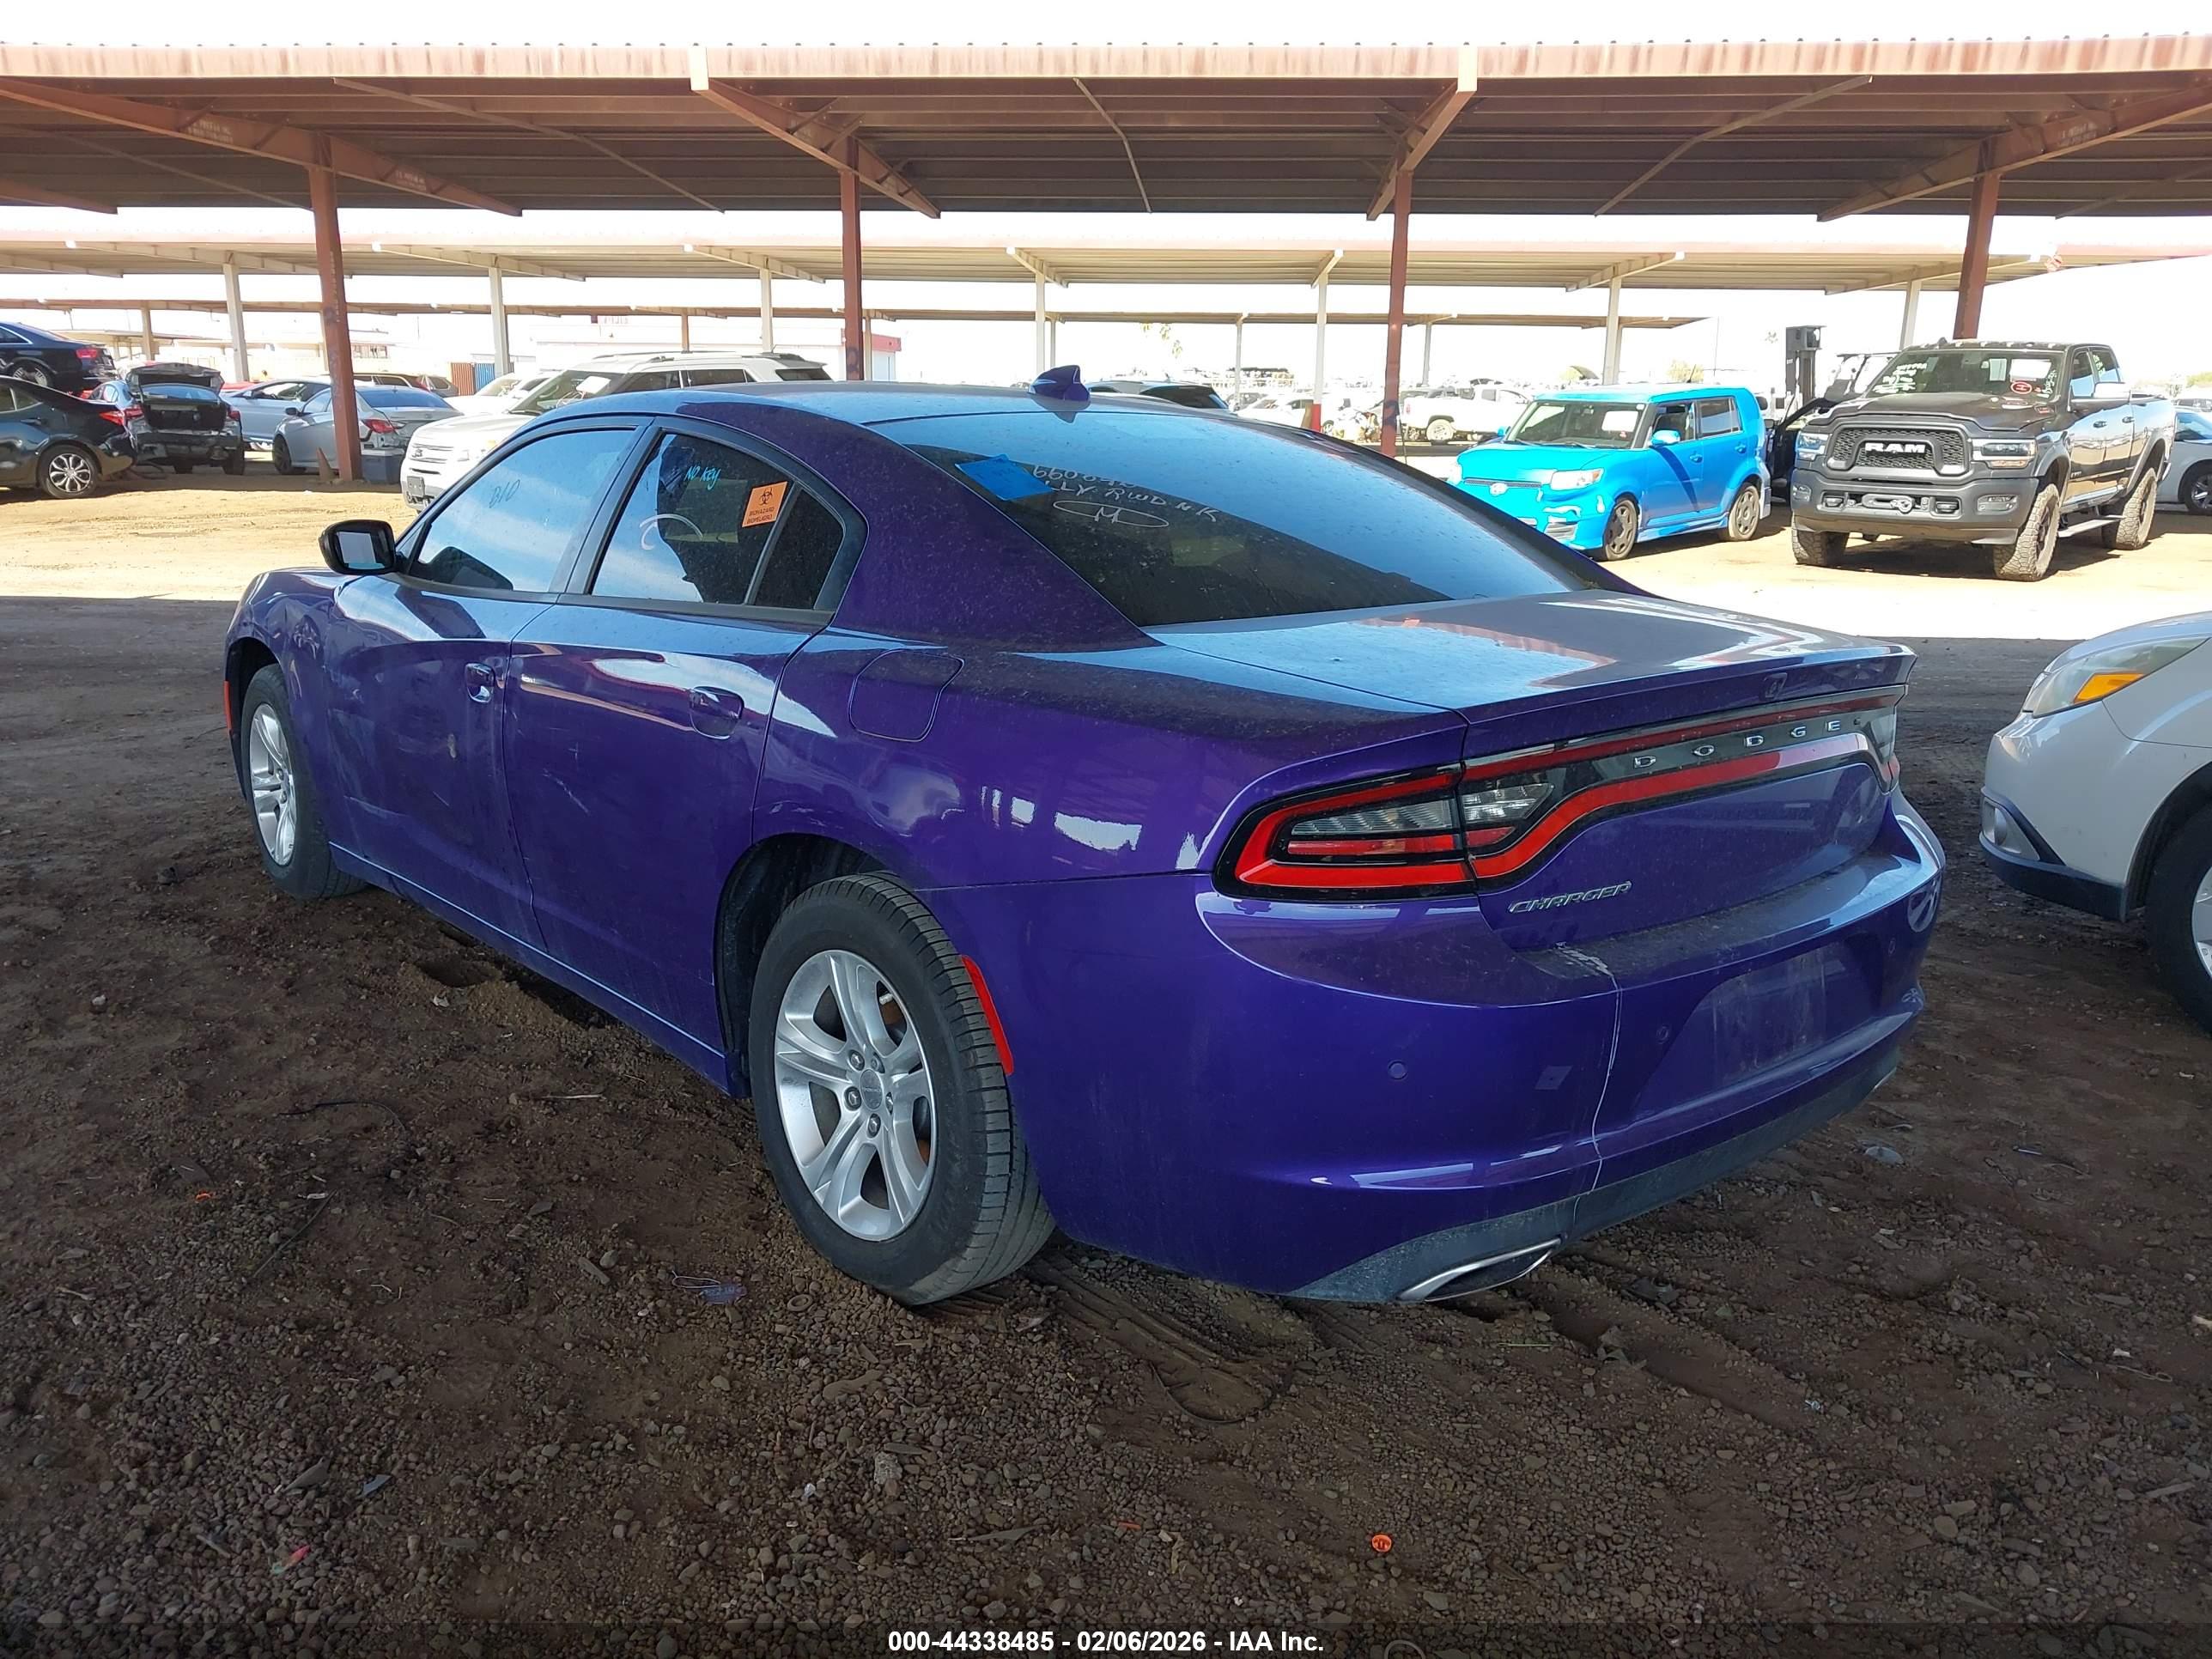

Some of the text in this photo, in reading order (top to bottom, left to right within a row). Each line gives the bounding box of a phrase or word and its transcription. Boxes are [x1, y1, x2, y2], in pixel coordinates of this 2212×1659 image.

[1864, 442, 1926, 453] RAM
[1633, 720, 1842, 769] DODGE
[1508, 880, 1632, 913] CHARGER
